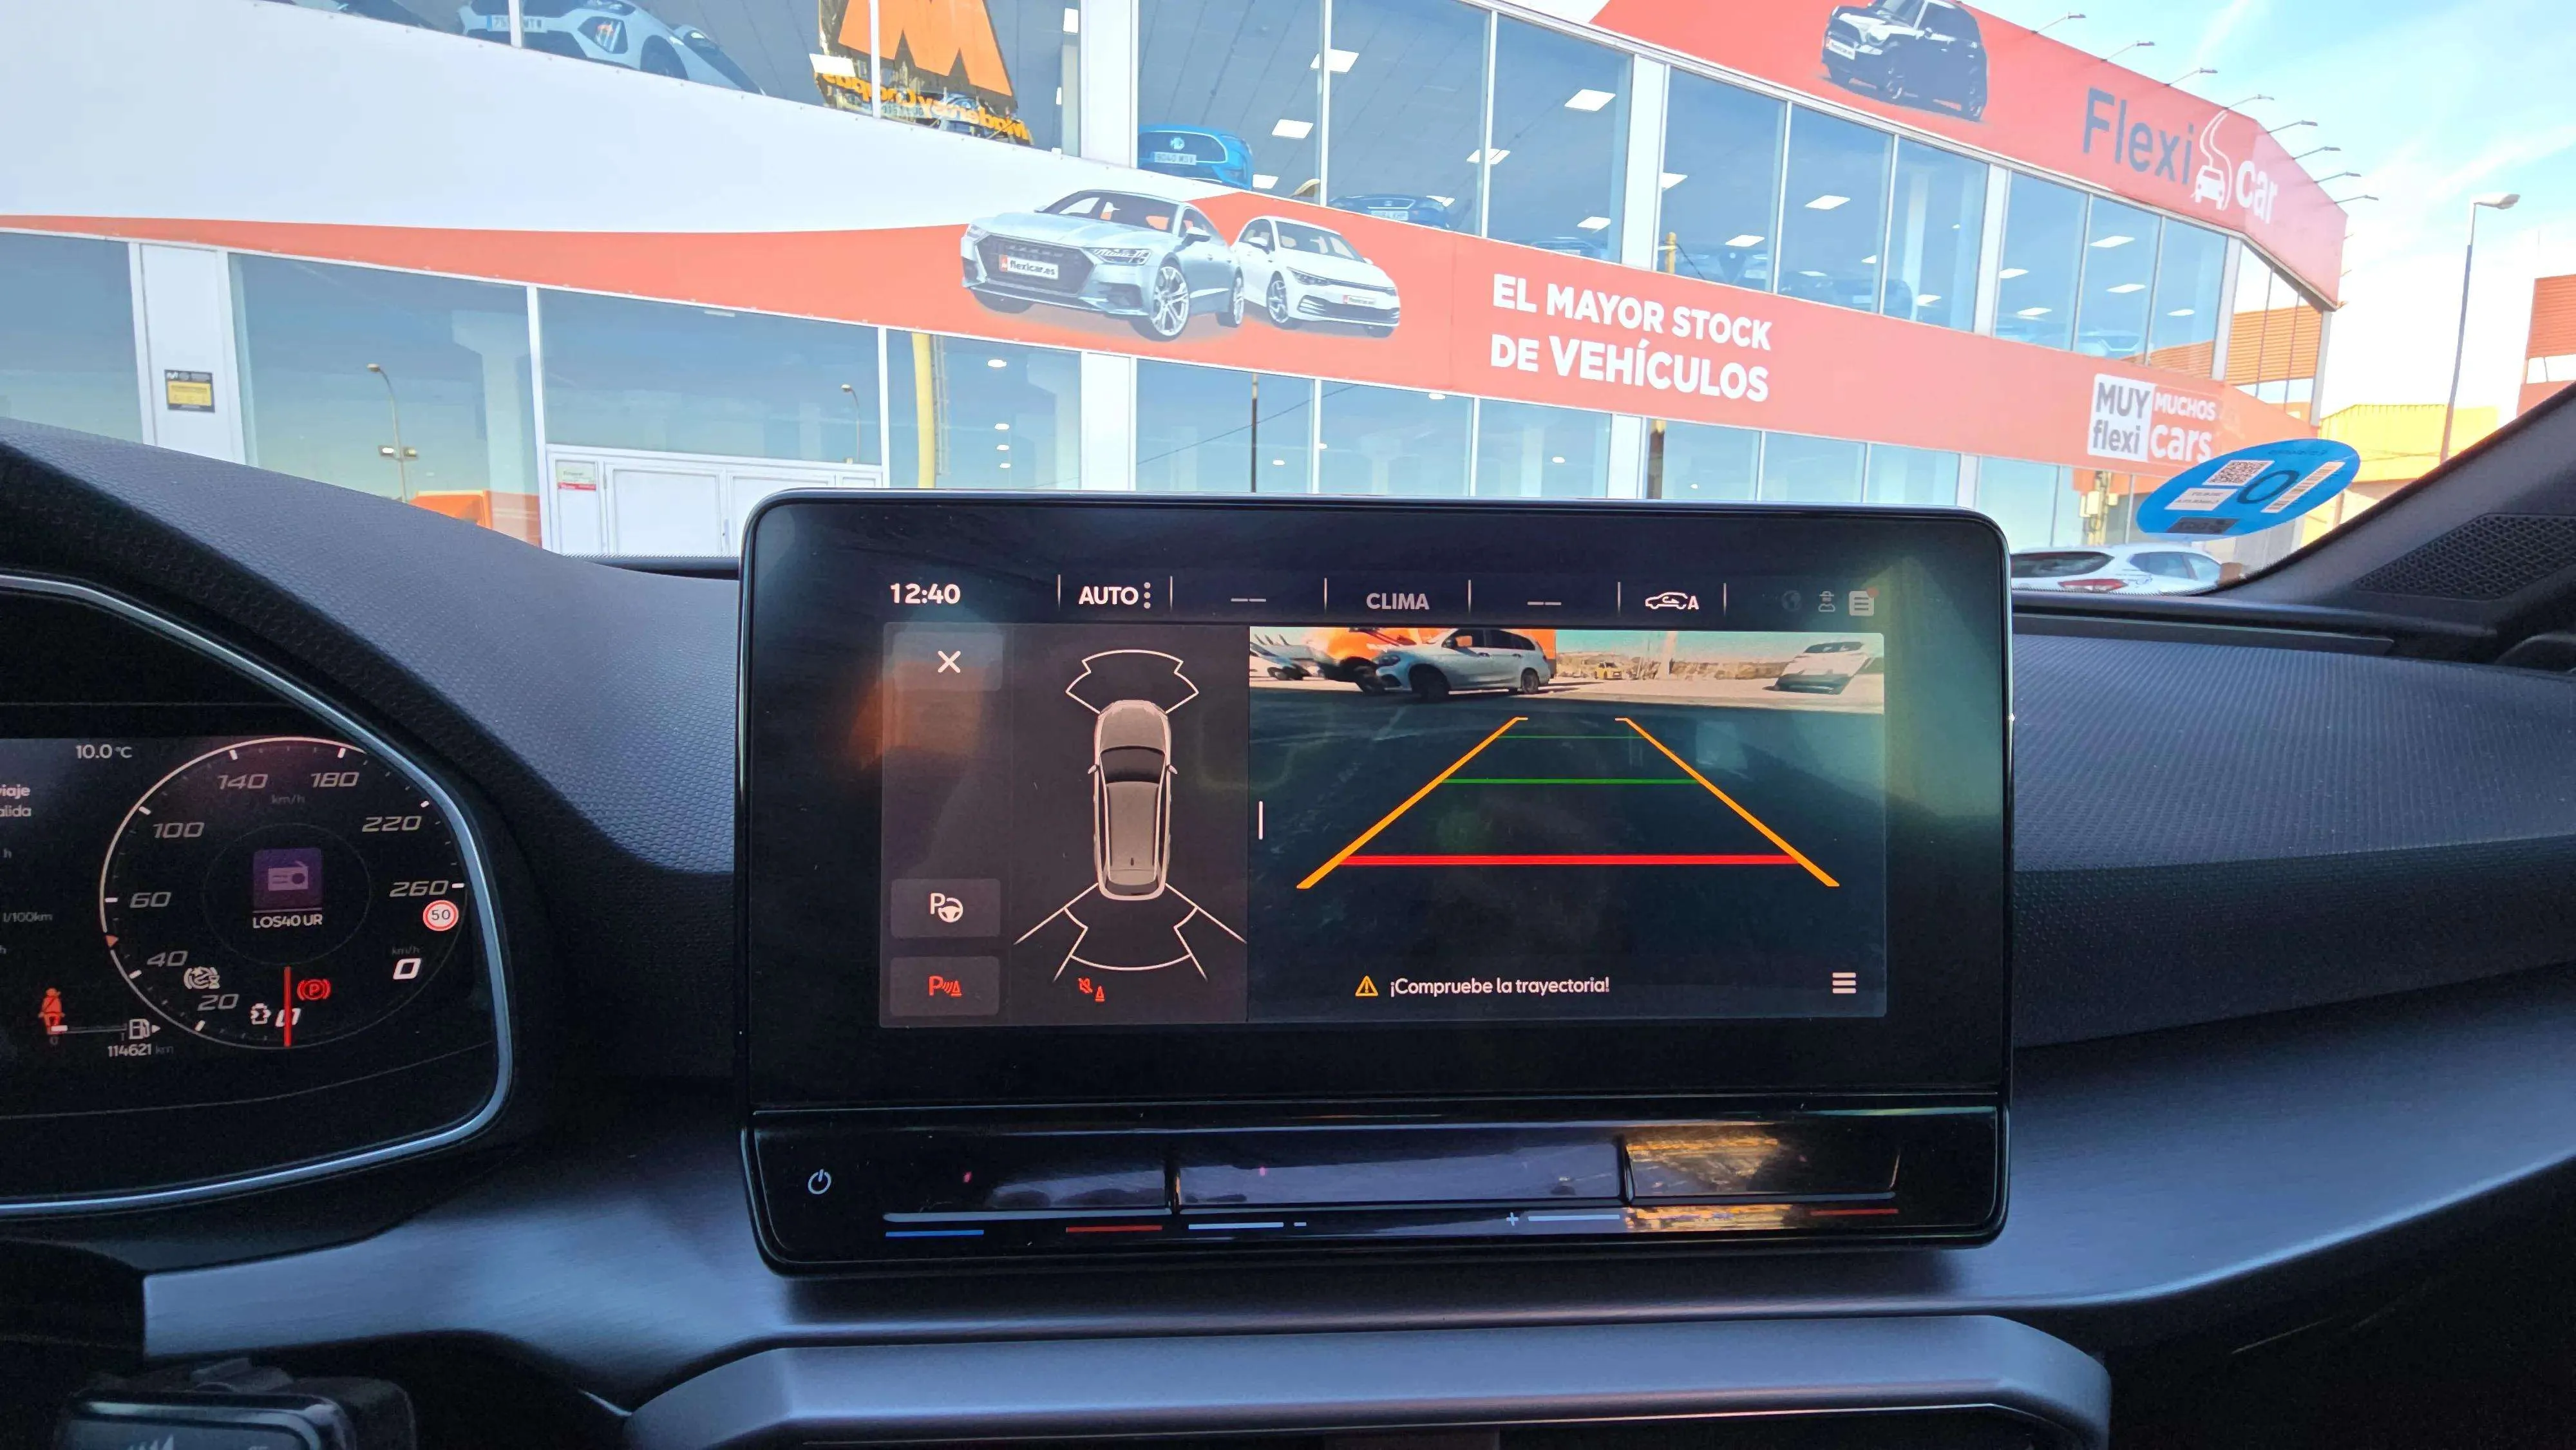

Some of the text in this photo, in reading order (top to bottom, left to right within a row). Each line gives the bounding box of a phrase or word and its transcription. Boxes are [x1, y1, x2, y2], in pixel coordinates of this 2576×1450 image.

[2083, 88, 2194, 185] Flexi
[1493, 274, 1772, 350] EL MAYOR STOCK
[1490, 334, 1770, 402] DE VEHÍCULOS
[2096, 382, 2217, 421] MUY MUCHOS
[2093, 419, 2212, 463] flexi cars
[890, 583, 961, 604] 12:40
[1079, 586, 1139, 605] AUTO
[1366, 593, 1430, 610] CLIMA
[76, 744, 113, 759] 10.0
[217, 774, 269, 789] 140
[310, 772, 360, 788] 180
[270, 794, 306, 805] km/h
[153, 822, 205, 838] 100
[362, 816, 422, 833] 220
[390, 880, 449, 897] 260
[130, 892, 171, 909] 60
[303, 914, 323, 927] UR
[431, 909, 451, 921] 50
[147, 950, 188, 966] 40
[392, 945, 420, 956] km/h
[393, 958, 422, 980] 0
[1390, 976, 1610, 997] ¡Compruebe la trayectoria!
[197, 993, 240, 1011] 20
[108, 1043, 152, 1058] 114621
